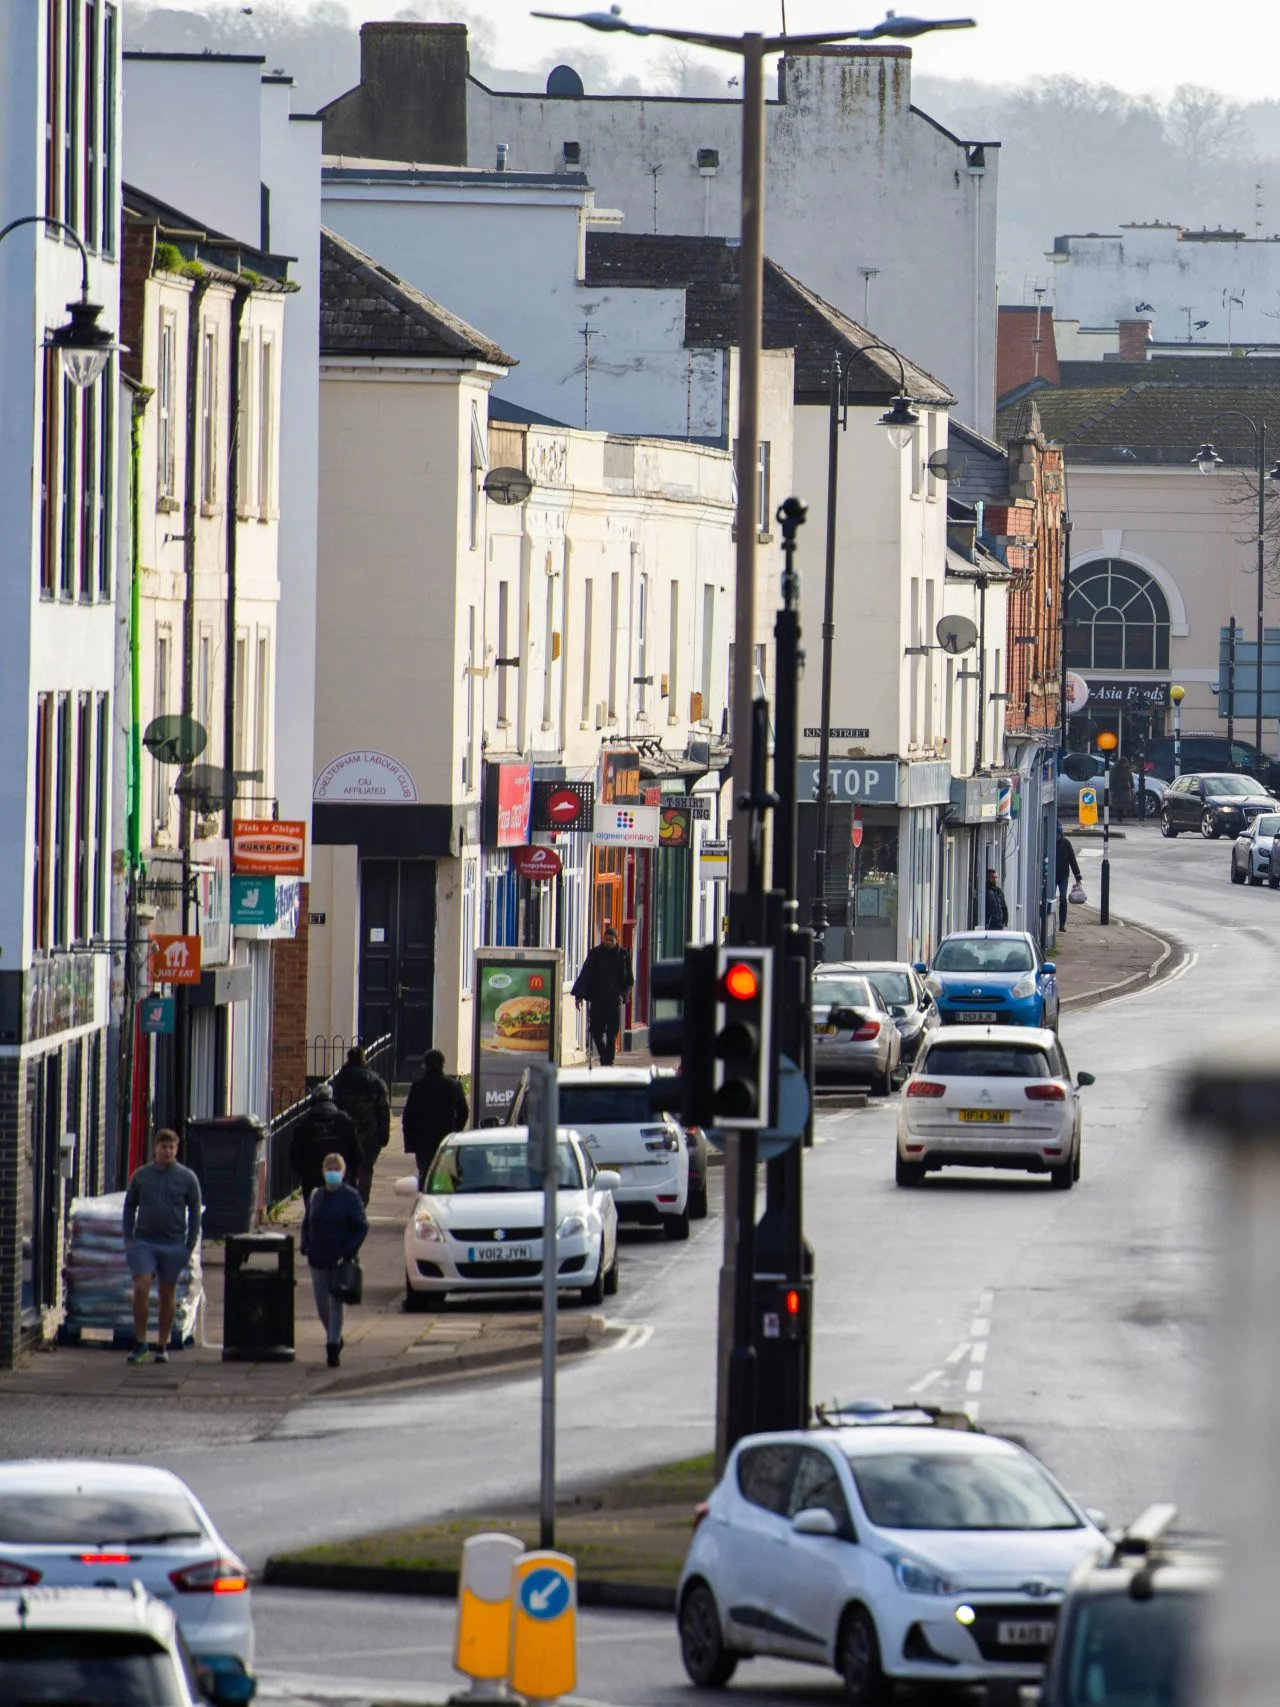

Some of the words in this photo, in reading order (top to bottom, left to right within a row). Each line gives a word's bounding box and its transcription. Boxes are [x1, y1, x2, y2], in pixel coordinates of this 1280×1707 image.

[806, 729, 822, 737] KIN
[832, 729, 868, 738] STREET
[318, 755, 361, 797] CHELTENHAM
[364, 754, 400, 775] LABOUR
[397, 774, 411, 798] CLUB
[812, 769, 880, 796] STOP
[344, 787, 386, 795] AFFILIATED
[666, 797, 705, 808] T-SHIRT
[692, 809, 711, 820] ING
[237, 823, 260, 832] Fish
[271, 823, 301, 834] Chips
[520, 861, 557, 870] hungryhouse
[155, 968, 177, 978] JUST
[178, 969, 195, 978] EAT
[485, 1090, 515, 1103] McP
[478, 1248, 503, 1259] VO12
[505, 1246, 527, 1258] JYN
